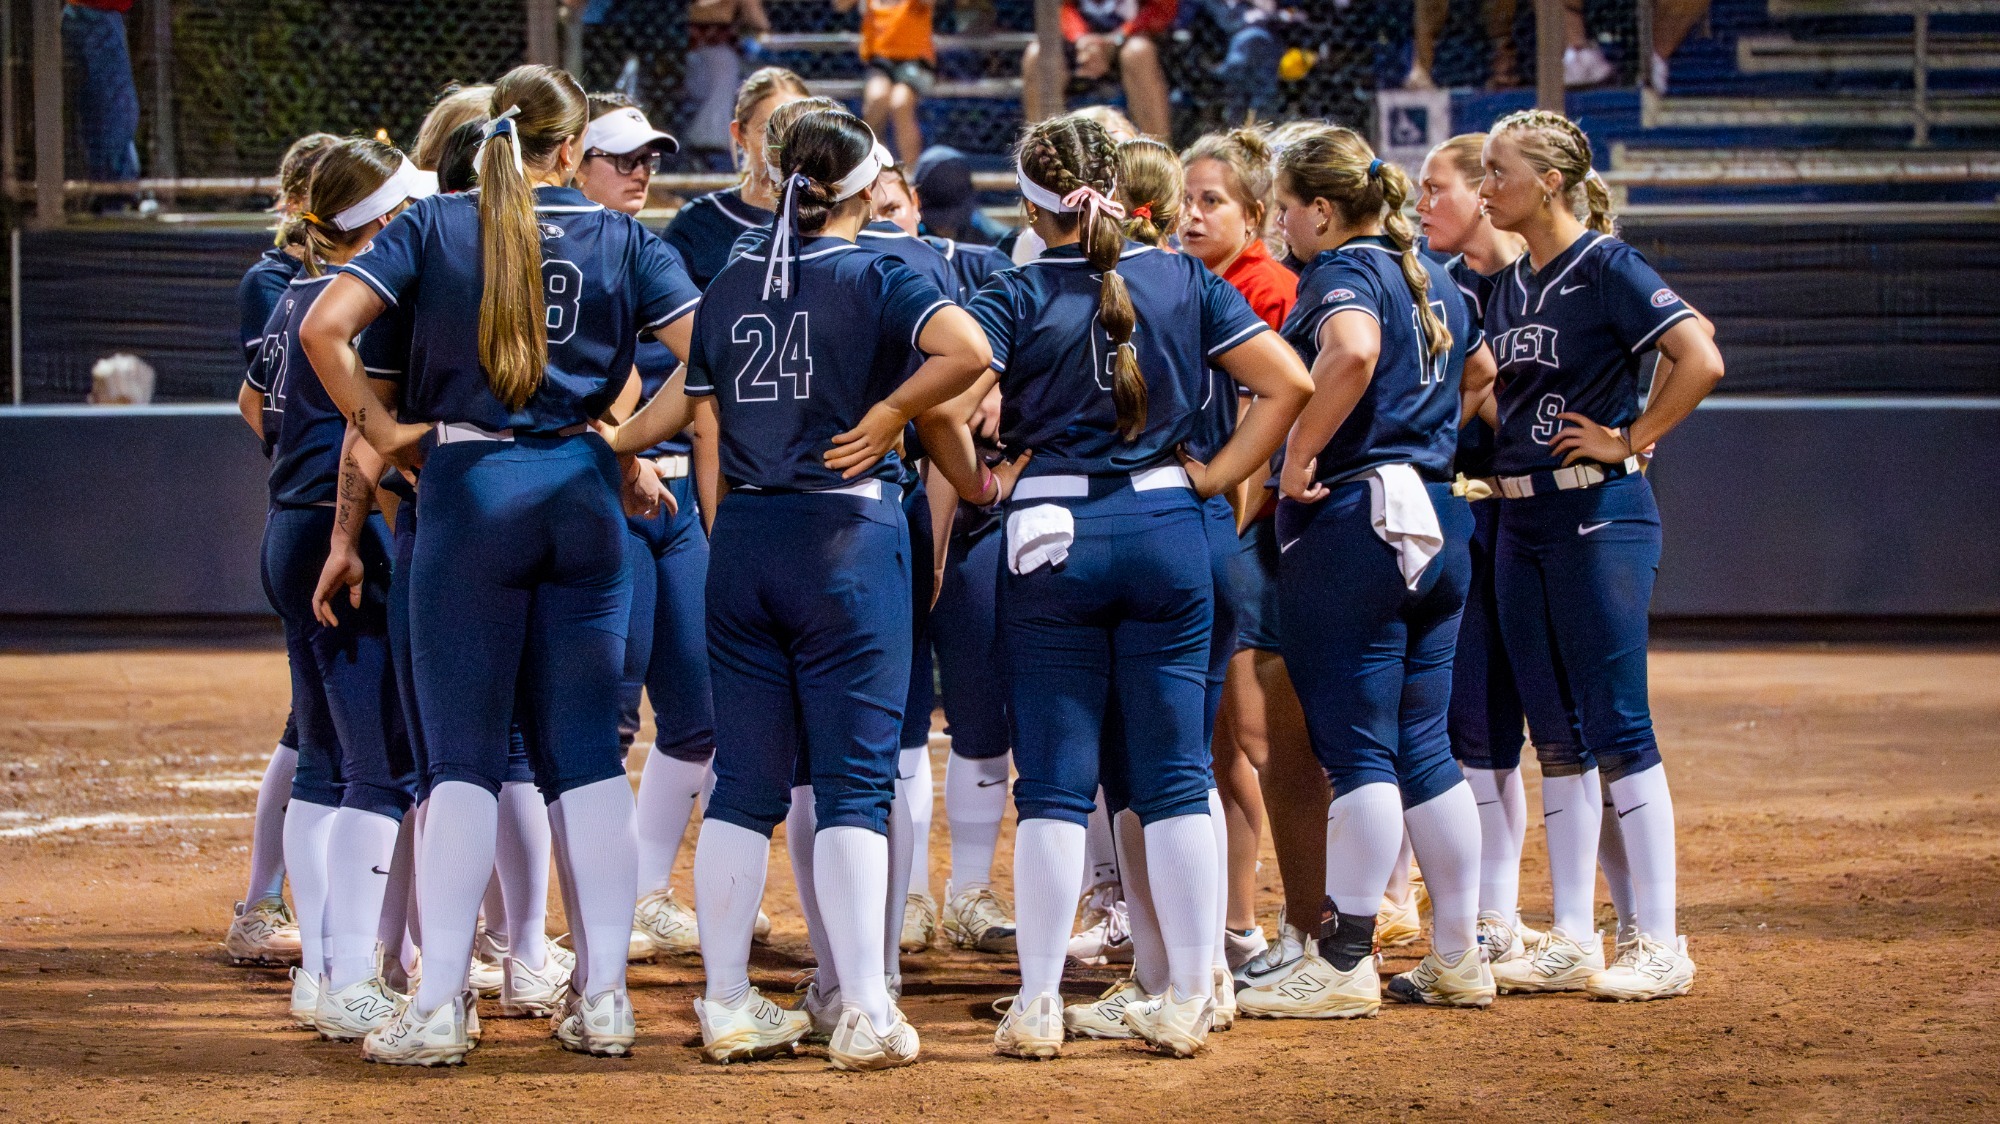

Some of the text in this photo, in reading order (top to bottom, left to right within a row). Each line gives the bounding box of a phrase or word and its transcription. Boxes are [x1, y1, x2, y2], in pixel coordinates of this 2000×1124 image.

[538, 259, 583, 344] 8
[731, 311, 813, 402] 24
[1492, 323, 1560, 370] USI
[1530, 392, 1566, 445] 9
